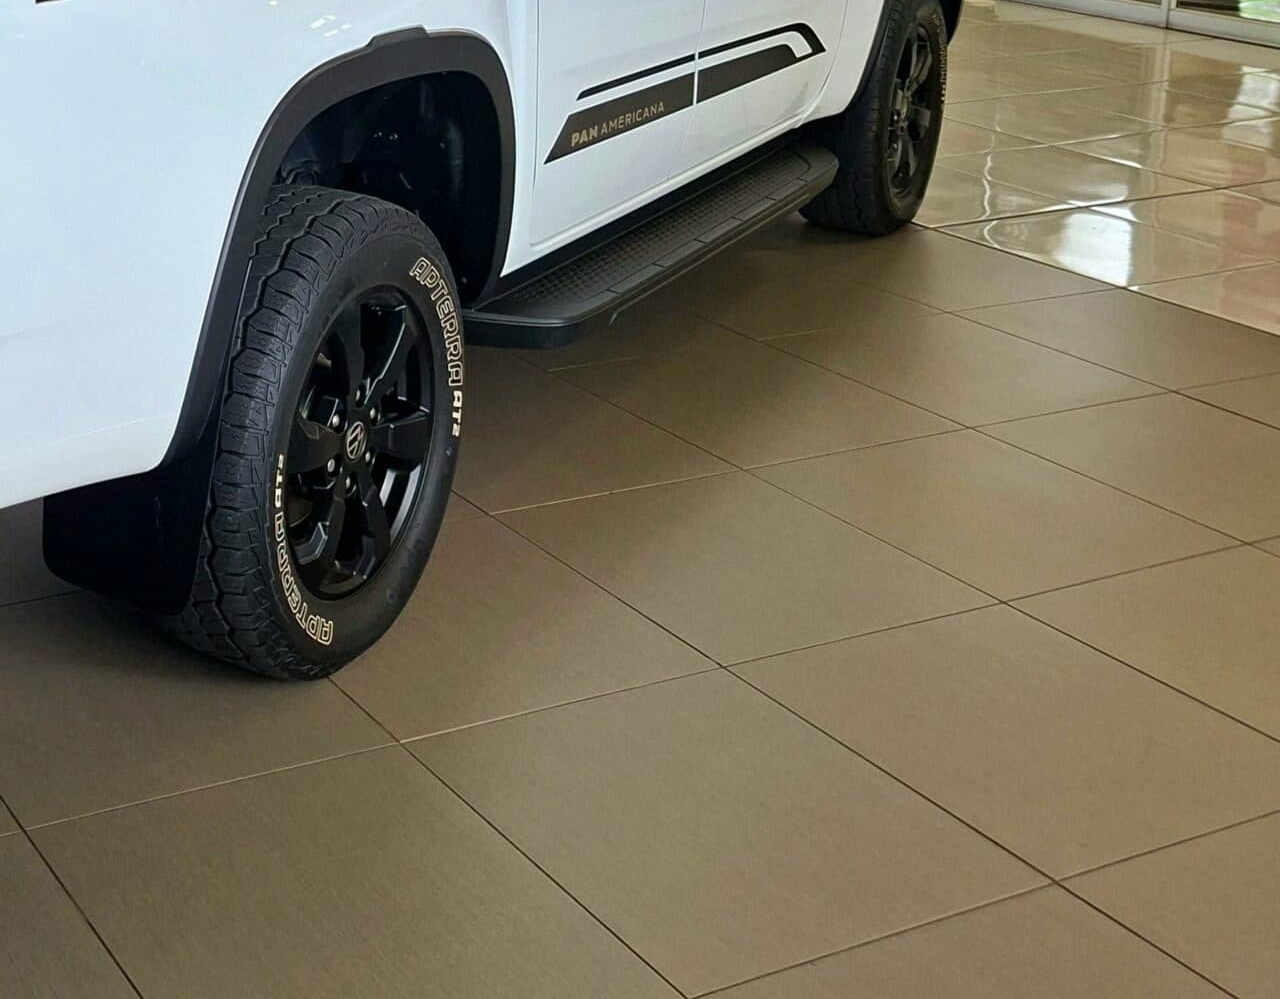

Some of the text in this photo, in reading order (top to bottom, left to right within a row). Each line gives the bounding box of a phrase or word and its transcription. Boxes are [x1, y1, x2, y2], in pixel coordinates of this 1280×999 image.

[570, 100, 665, 148] PAN AMERICANA
[408, 256, 464, 388] APTERRA
[274, 510, 334, 646] APTERRA
